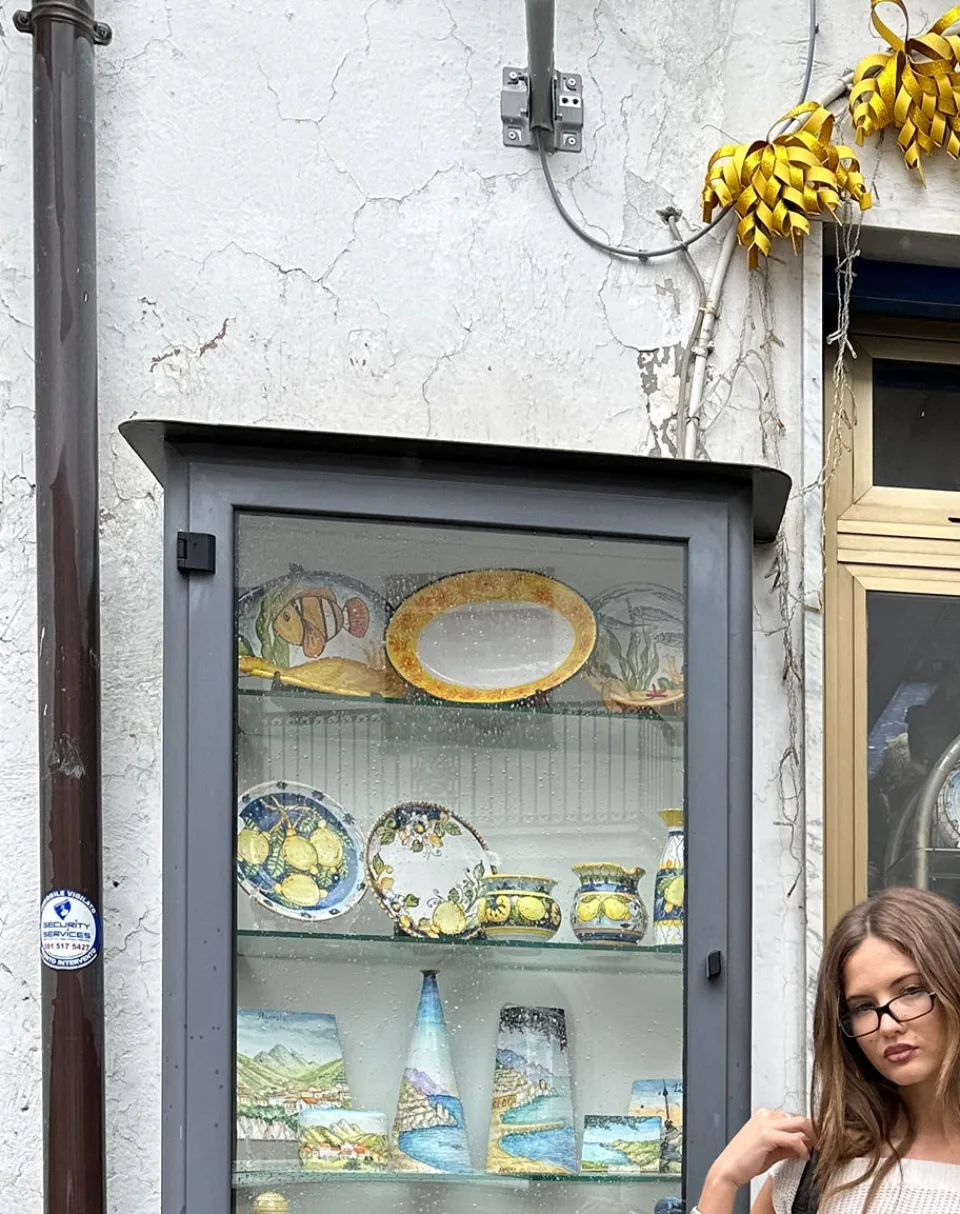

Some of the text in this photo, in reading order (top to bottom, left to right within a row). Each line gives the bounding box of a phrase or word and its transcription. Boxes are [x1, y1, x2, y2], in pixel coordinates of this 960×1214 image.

[67, 890, 97, 914] VIGILATO
[43, 919, 91, 929] SECURITY
[43, 929, 91, 939] SERVICES
[56, 942, 69, 950] 517
[72, 943, 90, 951] 5427
